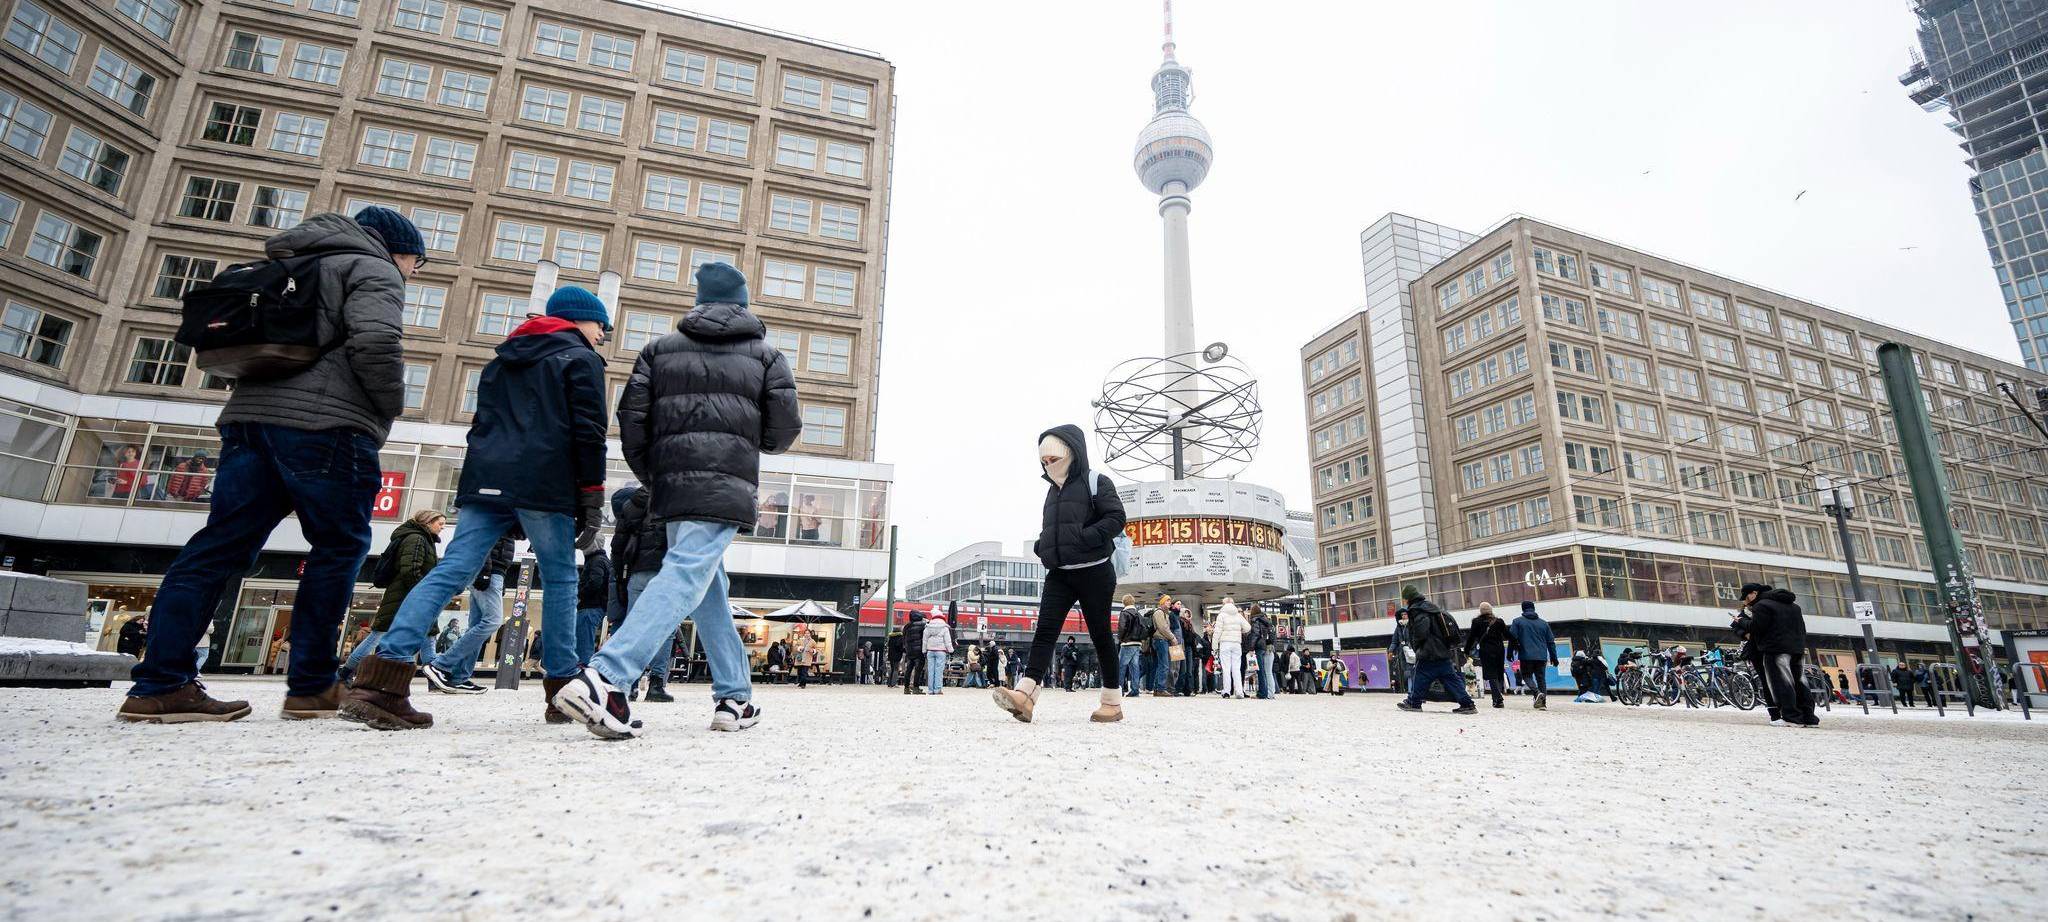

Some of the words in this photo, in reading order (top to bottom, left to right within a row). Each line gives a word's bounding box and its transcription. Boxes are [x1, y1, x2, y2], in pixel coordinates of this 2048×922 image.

[1143, 522, 1163, 540] 14
[1171, 521, 1192, 539] 15
[1199, 521, 1221, 539] 16
[1226, 523, 1245, 540] 17
[1250, 525, 1265, 544] 18
